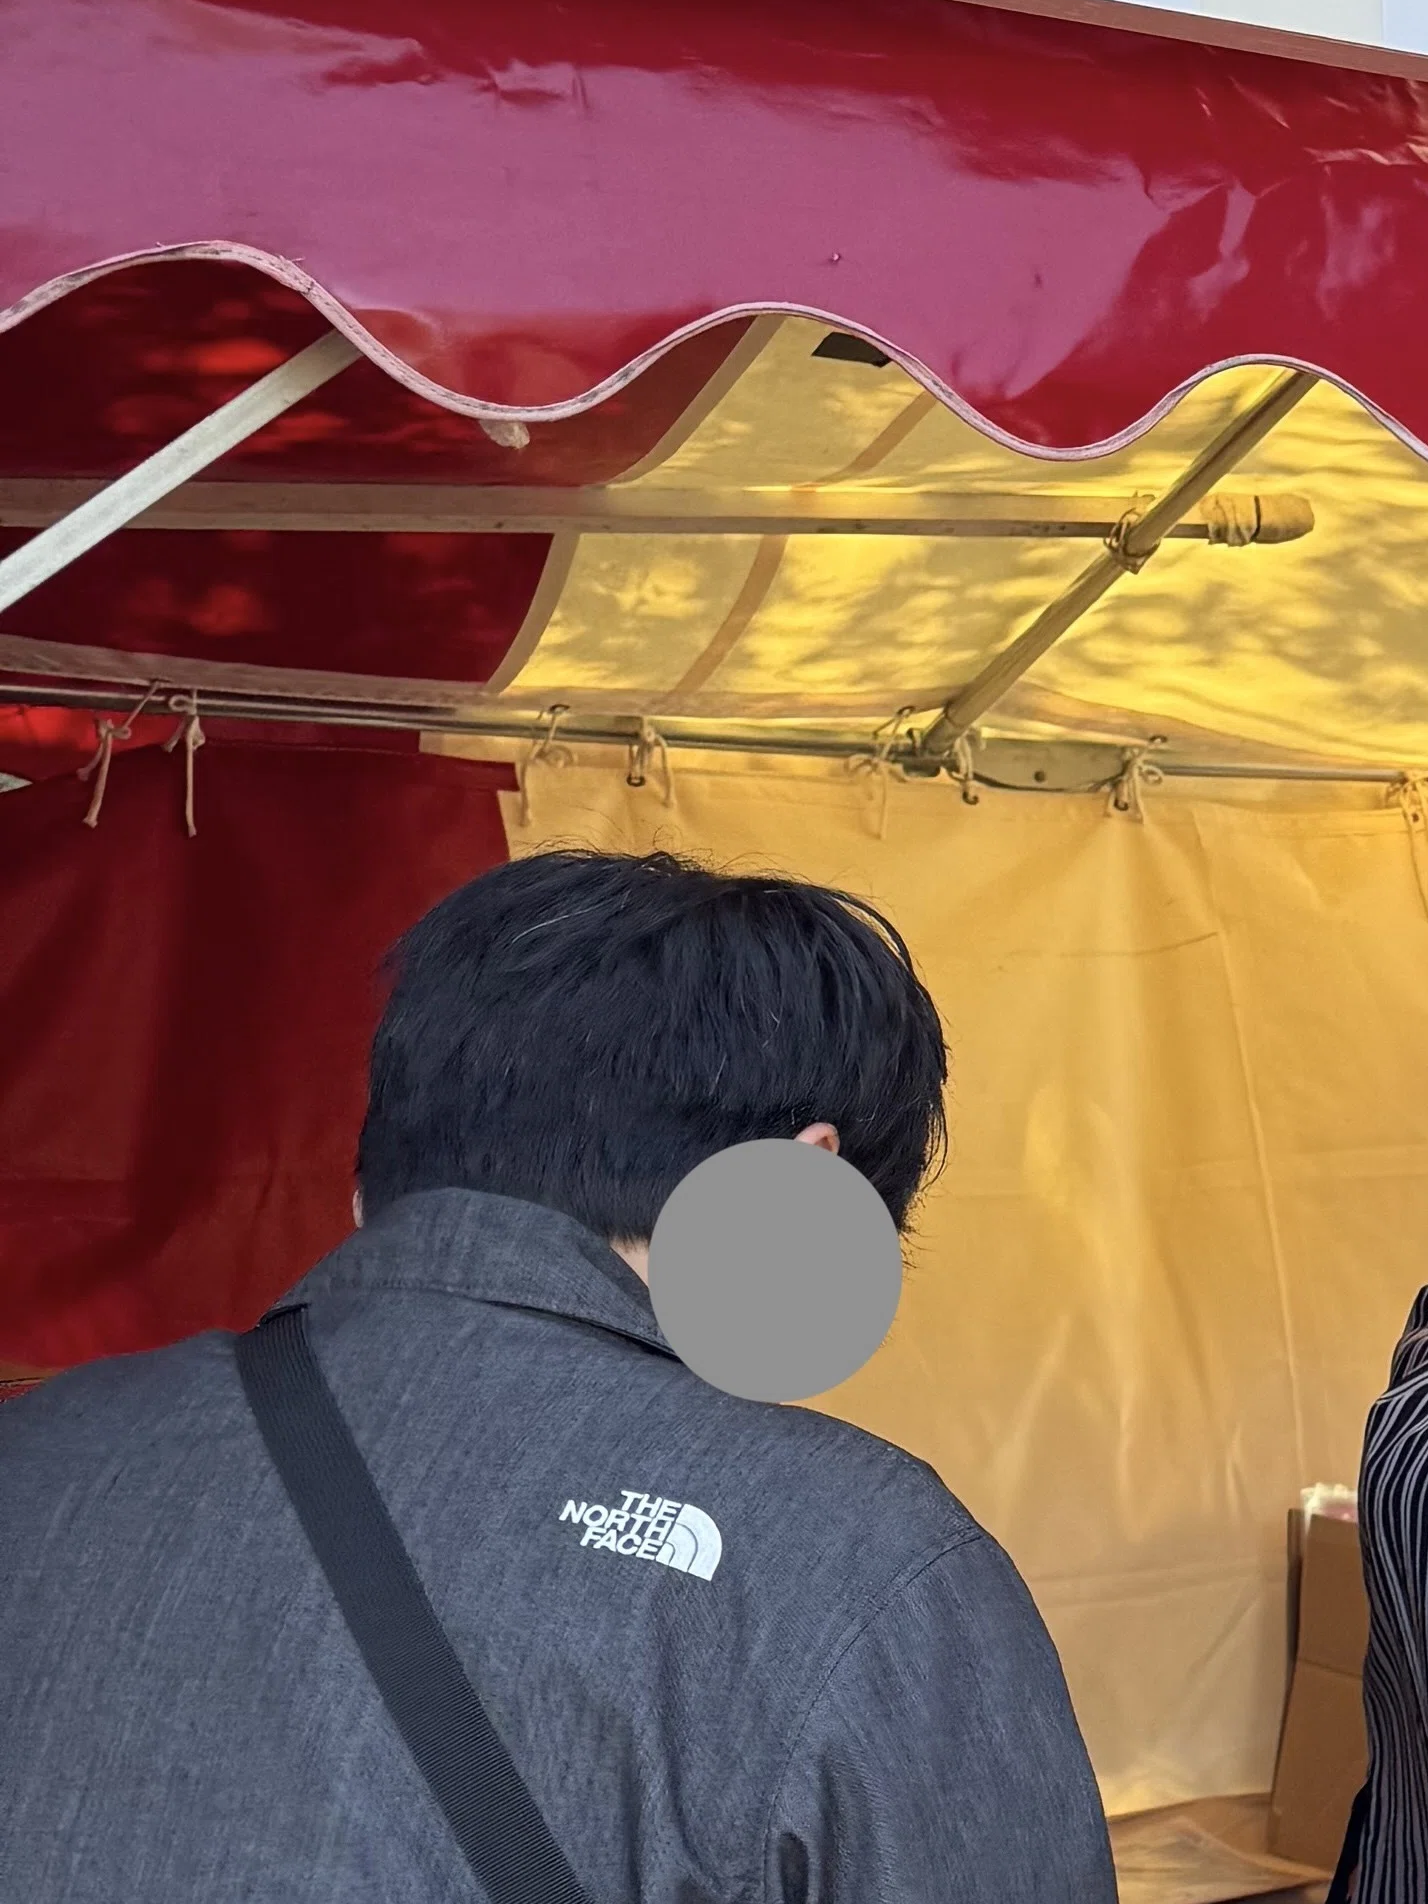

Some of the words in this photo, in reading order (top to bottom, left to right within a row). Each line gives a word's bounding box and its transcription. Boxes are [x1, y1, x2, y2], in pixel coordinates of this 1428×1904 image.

[558, 1499, 673, 1541] NORTH
[620, 1490, 682, 1521] THE
[580, 1527, 664, 1561] FACE
